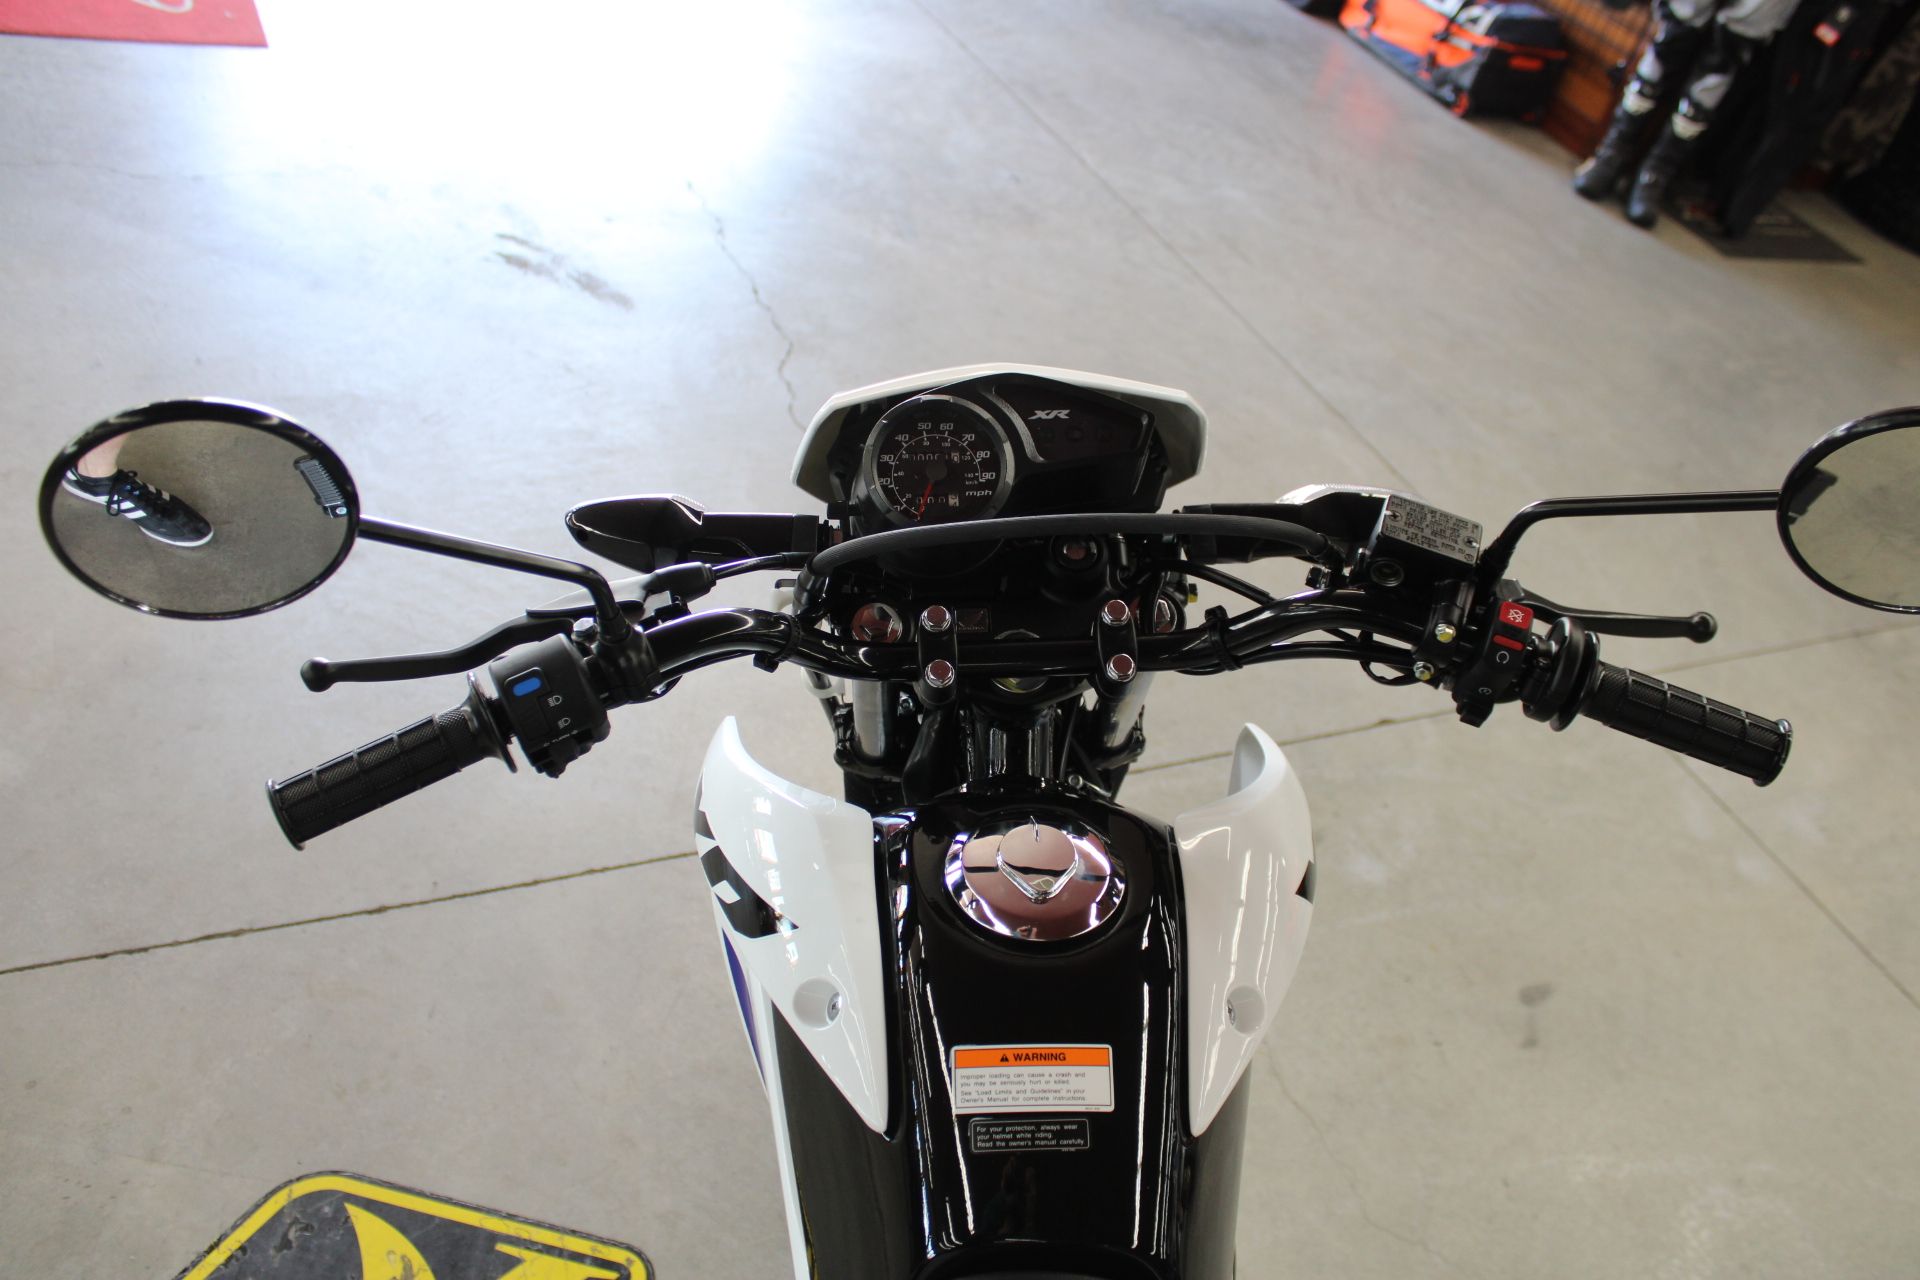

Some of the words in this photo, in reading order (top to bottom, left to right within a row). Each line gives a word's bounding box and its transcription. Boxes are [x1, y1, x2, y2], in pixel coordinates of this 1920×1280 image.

[1027, 409, 1070, 420] XR
[917, 422, 931, 430] 50
[940, 422, 953, 430] 60
[894, 433, 909, 441] 40
[962, 433, 975, 441] 70
[880, 454, 894, 462] 30
[976, 450, 990, 458] 80
[982, 472, 996, 480] 90
[878, 477, 891, 485] 20
[965, 489, 993, 497] mph
[1013, 1052, 1066, 1062] WARNING
[960, 1072, 986, 1080] Improper
[988, 1071, 1010, 1079] loading
[994, 1088, 1012, 1096] Limits
[987, 1095, 1009, 1103] Manual
[1022, 1095, 1050, 1103] complete
[1040, 1123, 1060, 1132] always
[977, 1140, 993, 1148] Read
[1008, 1139, 1031, 1147] owner's
